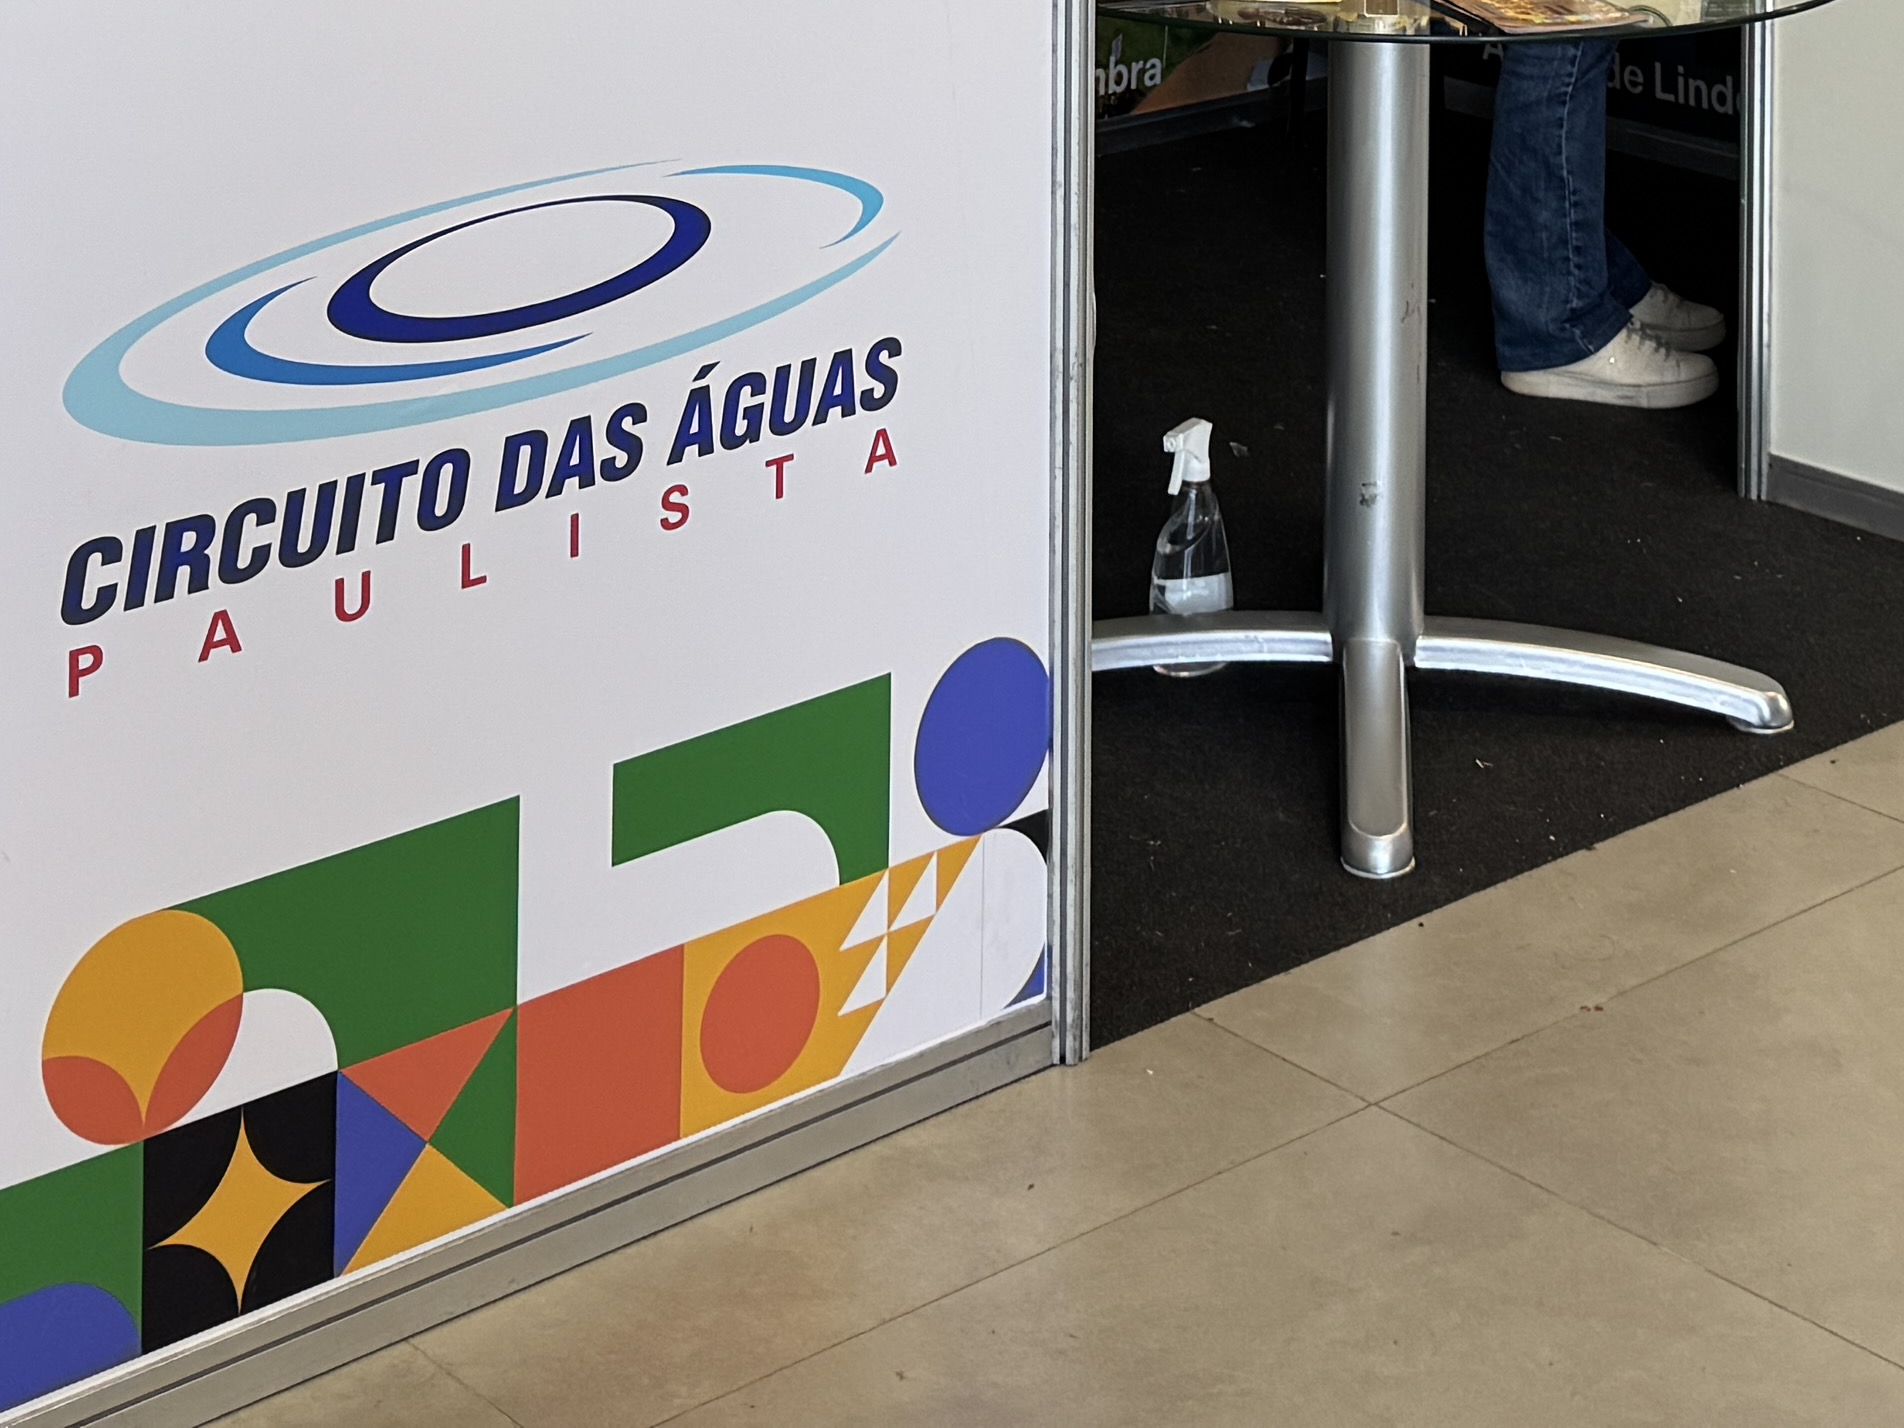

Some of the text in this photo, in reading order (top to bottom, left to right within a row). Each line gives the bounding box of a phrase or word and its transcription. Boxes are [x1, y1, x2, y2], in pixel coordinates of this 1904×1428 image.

[60, 337, 902, 625] CIRCUITO DAS ÁGUAS
[67, 428, 898, 698] PAULISTA
